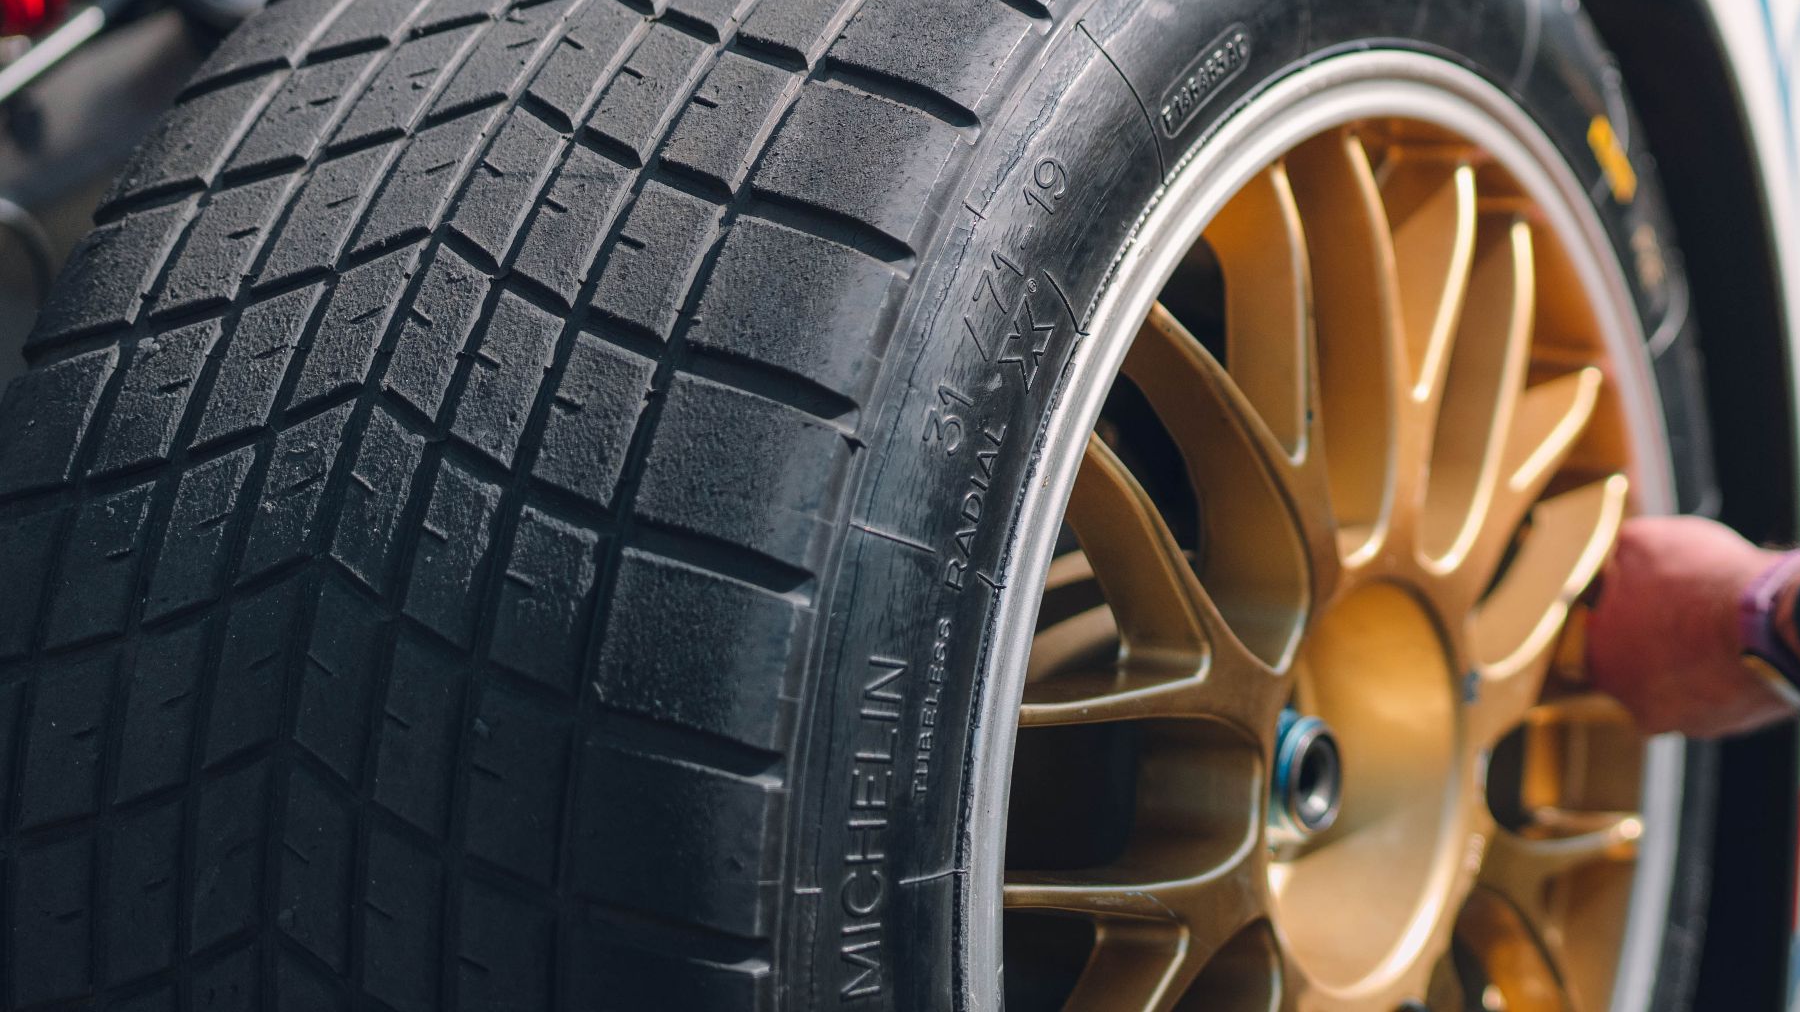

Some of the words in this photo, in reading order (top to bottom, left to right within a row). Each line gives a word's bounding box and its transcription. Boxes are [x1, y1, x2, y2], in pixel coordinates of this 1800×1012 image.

[944, 424, 1007, 591] RADIAL
[912, 617, 952, 797] TUBELESS
[840, 654, 910, 1002] MICHELIN
